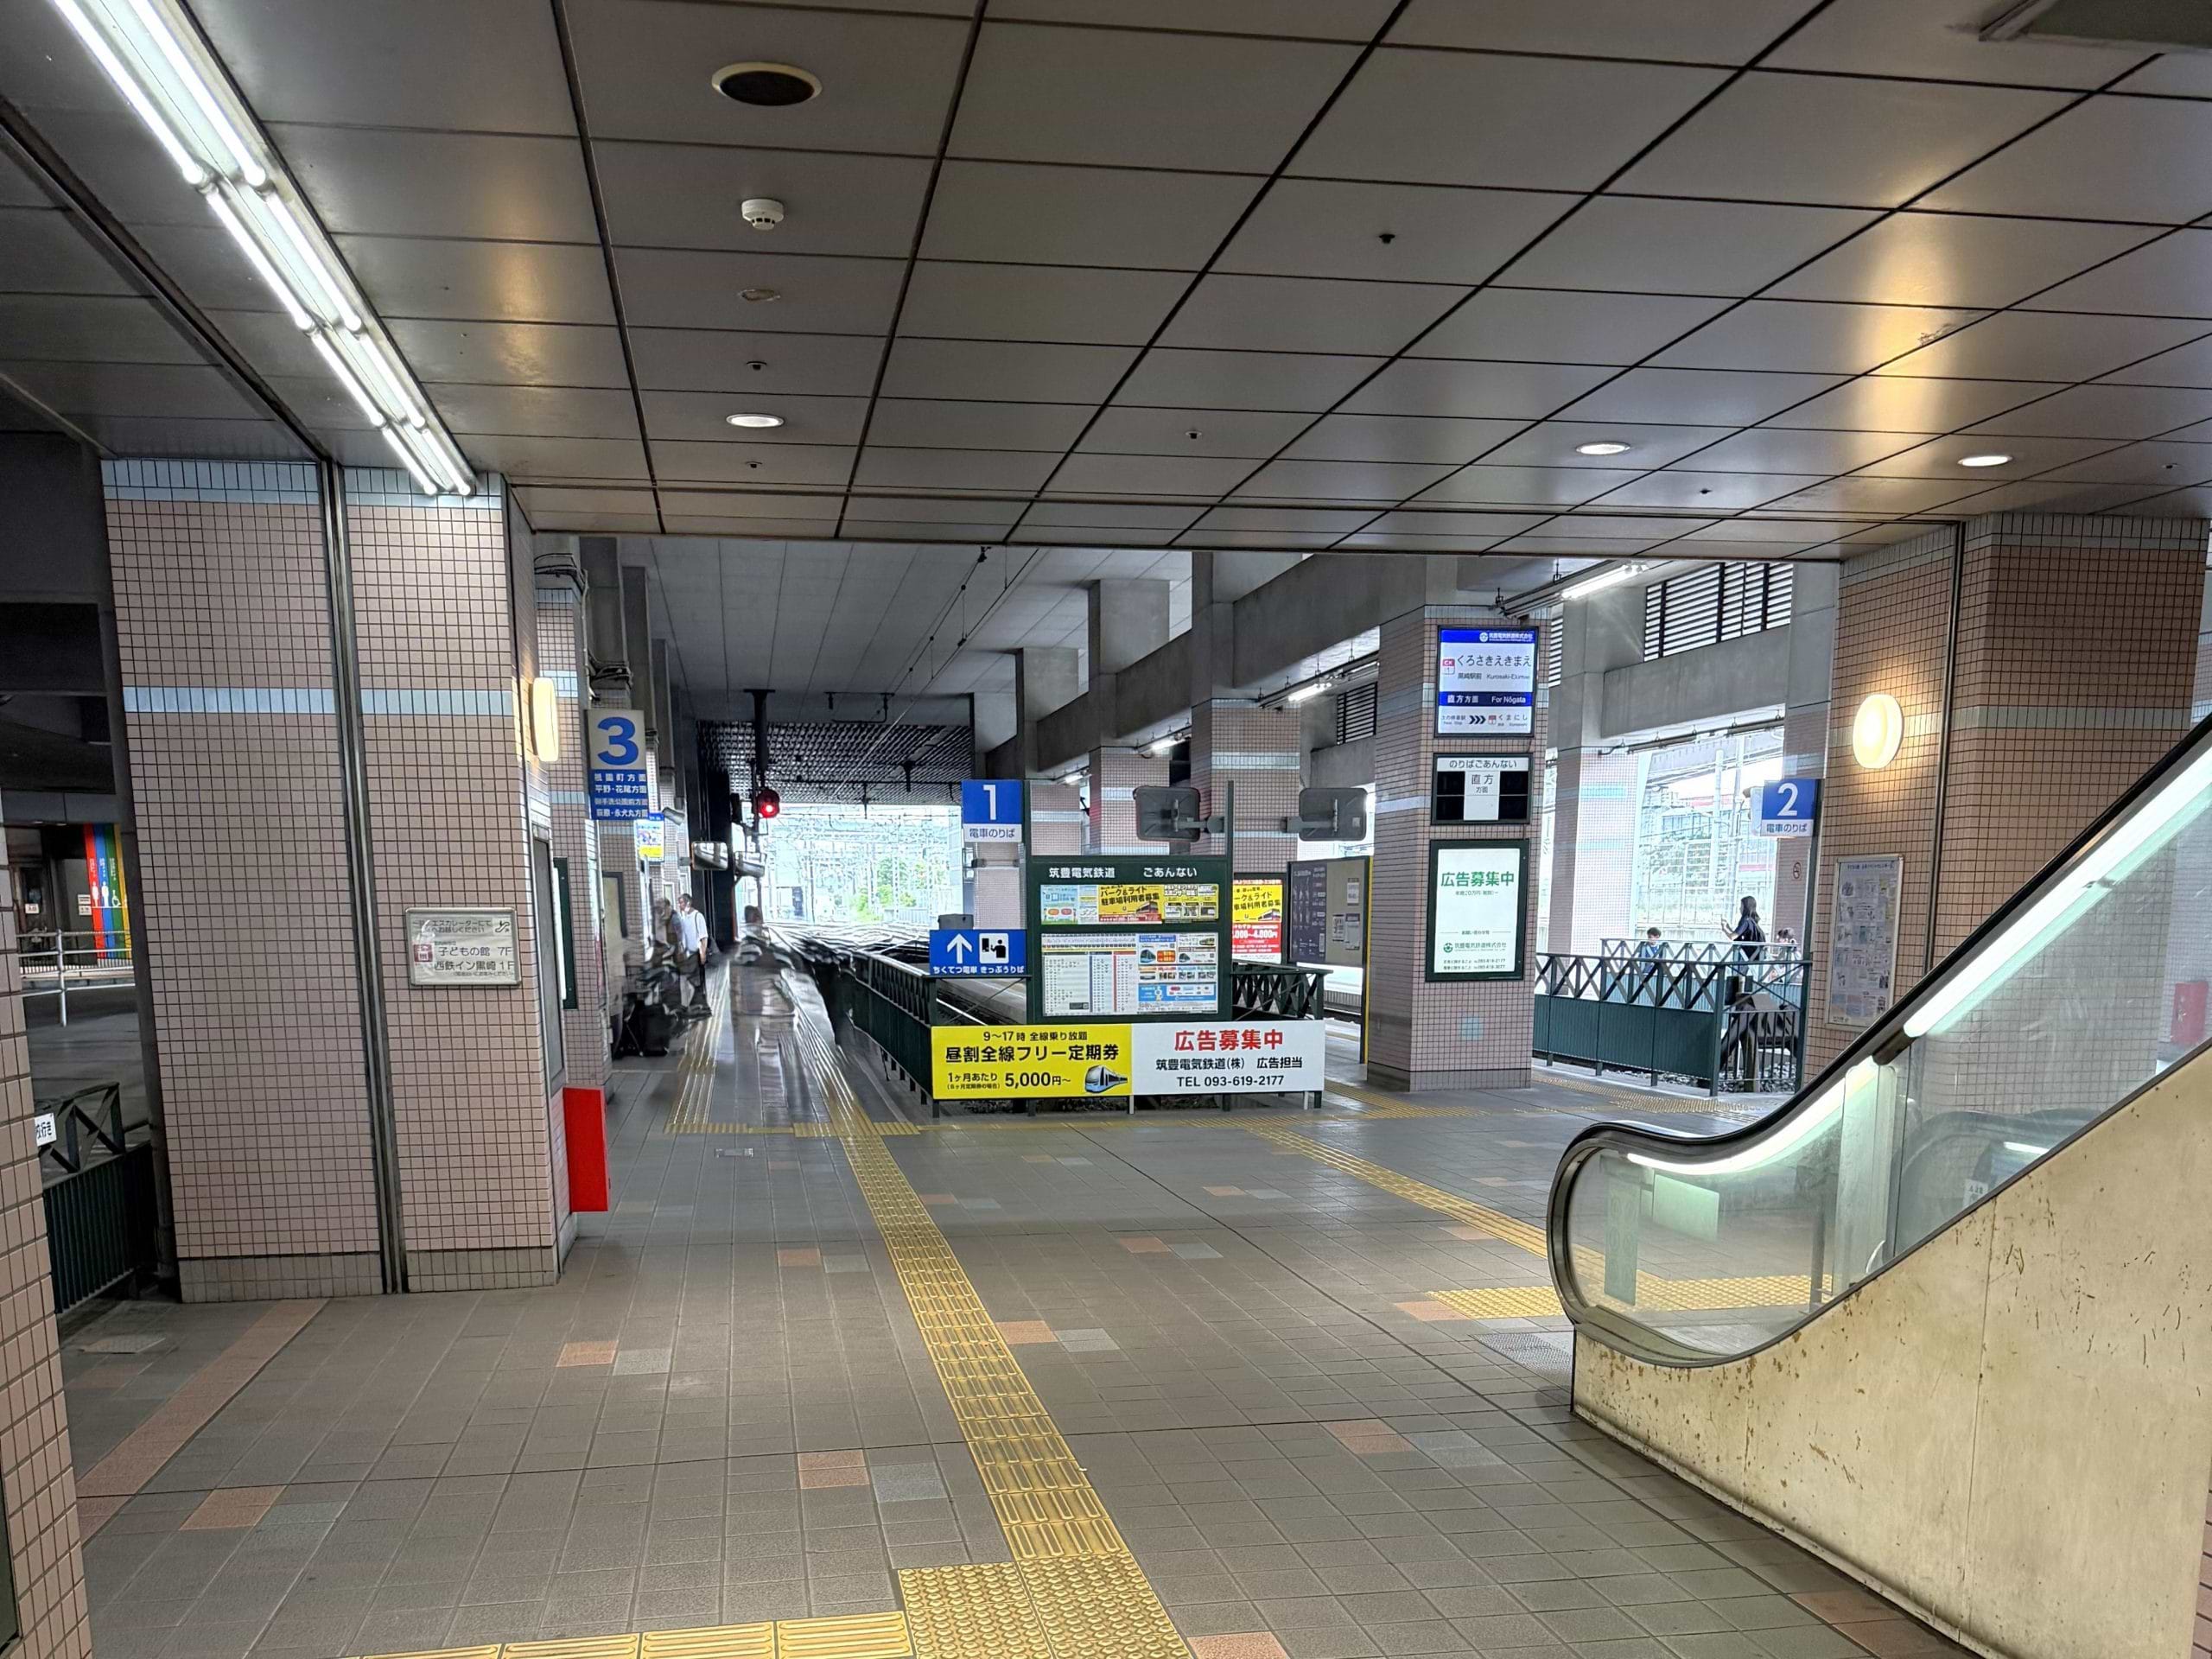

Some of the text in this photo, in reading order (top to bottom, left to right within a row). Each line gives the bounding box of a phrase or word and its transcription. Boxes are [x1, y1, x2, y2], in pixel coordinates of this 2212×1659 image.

[1457, 655, 1531, 666] くろさきえきまえ
[1447, 695, 1478, 703] 直方方面
[597, 716, 639, 766] 3
[1449, 760, 1517, 769] のりばごあんない
[1471, 774, 1494, 785] 直方
[982, 784, 996, 821] 1
[1777, 782, 1798, 817] 2
[969, 828, 1016, 840] 電車のりば
[1766, 823, 1808, 834] 電車のりば
[1049, 868, 1198, 879] 筑豊電気鉄道 ごあんない
[1440, 871, 1515, 887] 広告募集中
[1233, 891, 1273, 902] ーク&ライド
[1233, 899, 1281, 911] 車場利用者募集
[439, 946, 513, 957] 子どもの館 7F
[435, 960, 496, 971] 西鉄イン黒崎
[932, 965, 1025, 974] ちくてつ電車 きっぷうりば
[1029, 1031, 1088, 1041] 全線乗り放題
[1173, 1028, 1284, 1052] 広告募集中
[945, 1044, 1120, 1063] 昼割全線フリー定期券
[1155, 1056, 1303, 1071] 筑豊電気鉄道(株) 広告担当
[947, 1072, 998, 1083] 1ヶ月あたり
[1176, 1075, 1285, 1087] TEL 093-619-2177
